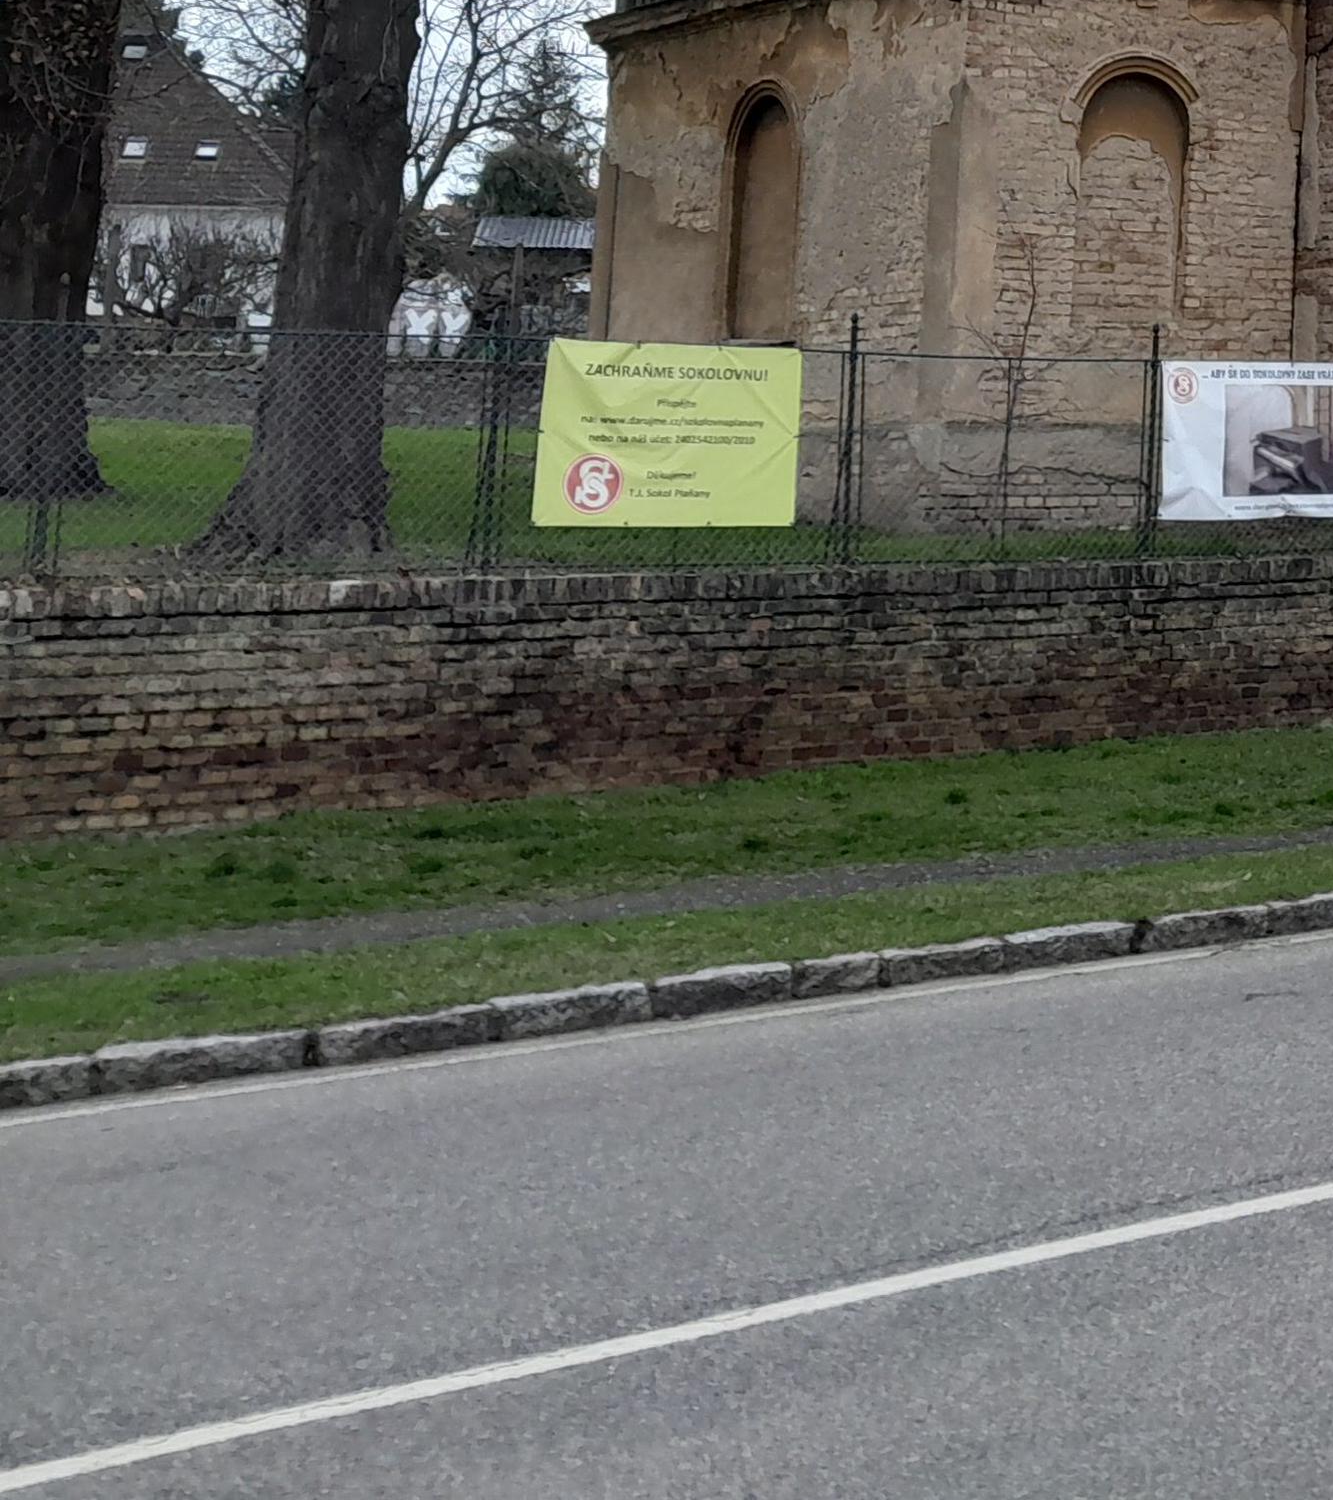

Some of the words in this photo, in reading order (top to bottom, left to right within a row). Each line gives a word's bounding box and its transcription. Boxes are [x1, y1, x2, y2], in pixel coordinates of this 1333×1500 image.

[584, 363, 675, 379] ZACHRAŇME
[678, 367, 768, 381] SOKOLOVNU!
[646, 488, 672, 498] Sokol
